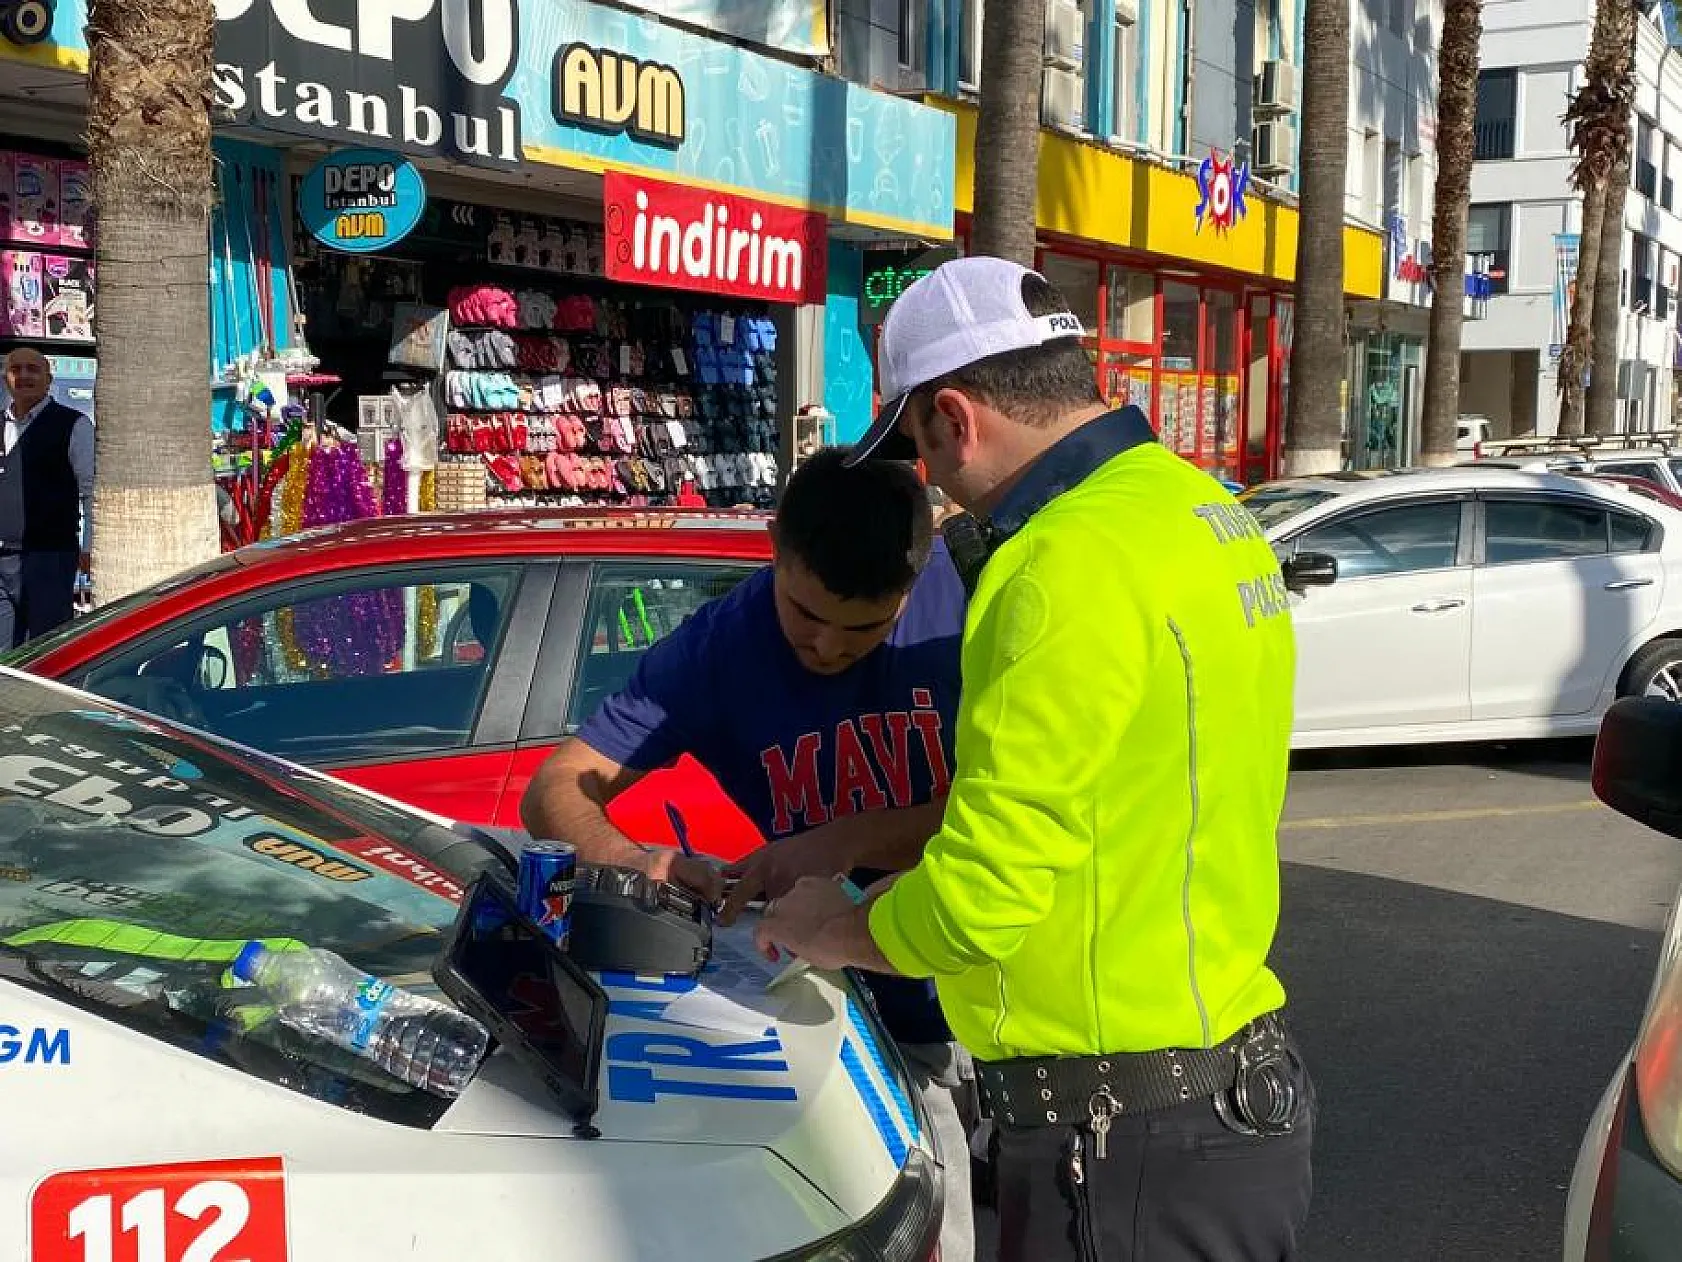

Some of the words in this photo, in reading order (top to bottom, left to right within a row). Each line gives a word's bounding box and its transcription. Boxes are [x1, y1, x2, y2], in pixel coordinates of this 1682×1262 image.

[213, 60, 520, 163] stanbul
[561, 46, 685, 141] AVM
[324, 162, 395, 193] DEPO
[337, 213, 385, 238] AVM
[633, 191, 802, 291] indirim
[760, 687, 950, 834] MAVİ
[66, 1179, 250, 1262] 112
